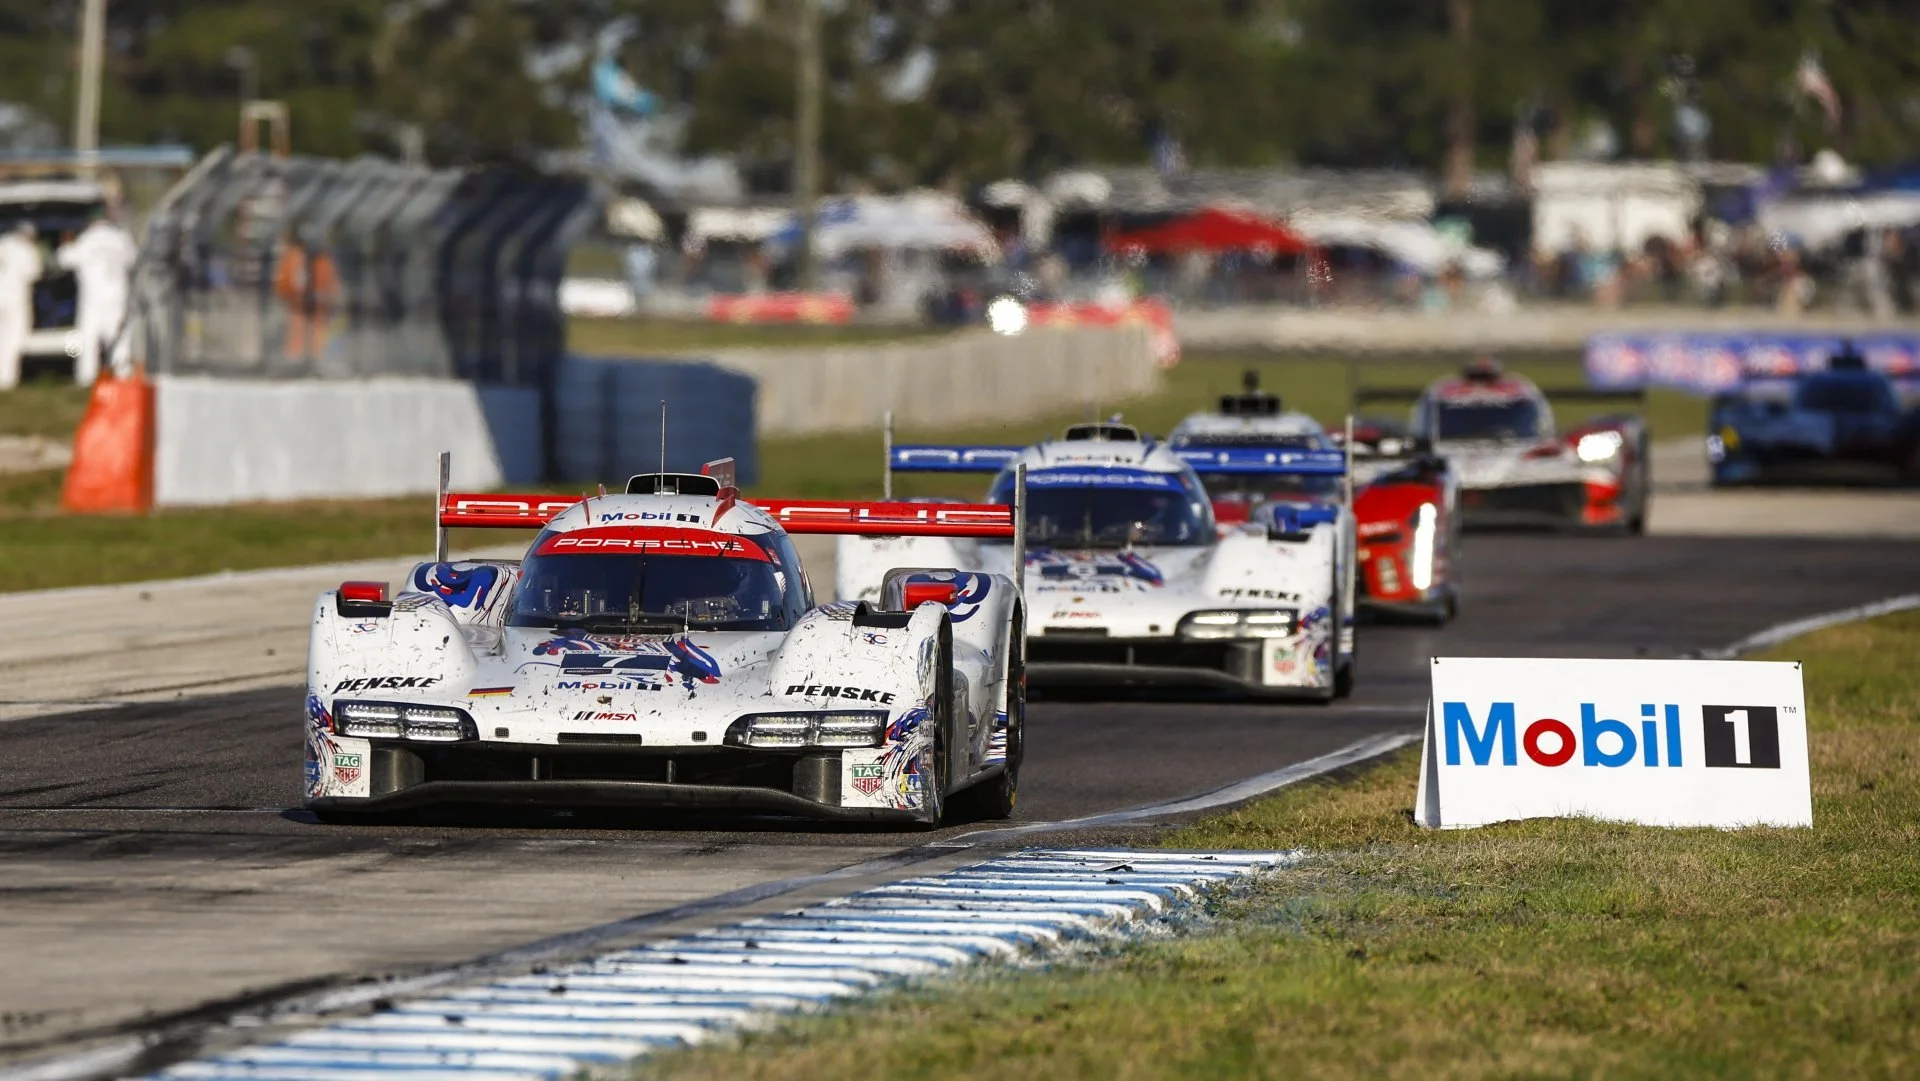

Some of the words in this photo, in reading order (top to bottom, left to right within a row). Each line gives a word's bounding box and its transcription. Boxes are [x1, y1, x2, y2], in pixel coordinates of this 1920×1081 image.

[601, 512, 671, 523] Mobil
[553, 538, 745, 551] PORSCHE
[598, 655, 638, 667] 7
[331, 676, 440, 695] PENSKE
[557, 682, 631, 690] Mobil
[785, 685, 896, 705] PENSKE
[593, 713, 637, 721] IMSA
[1443, 701, 1683, 767] Mobil
[336, 756, 359, 766] TAG
[335, 767, 359, 783] HEUER
[854, 778, 882, 793] HEUER
